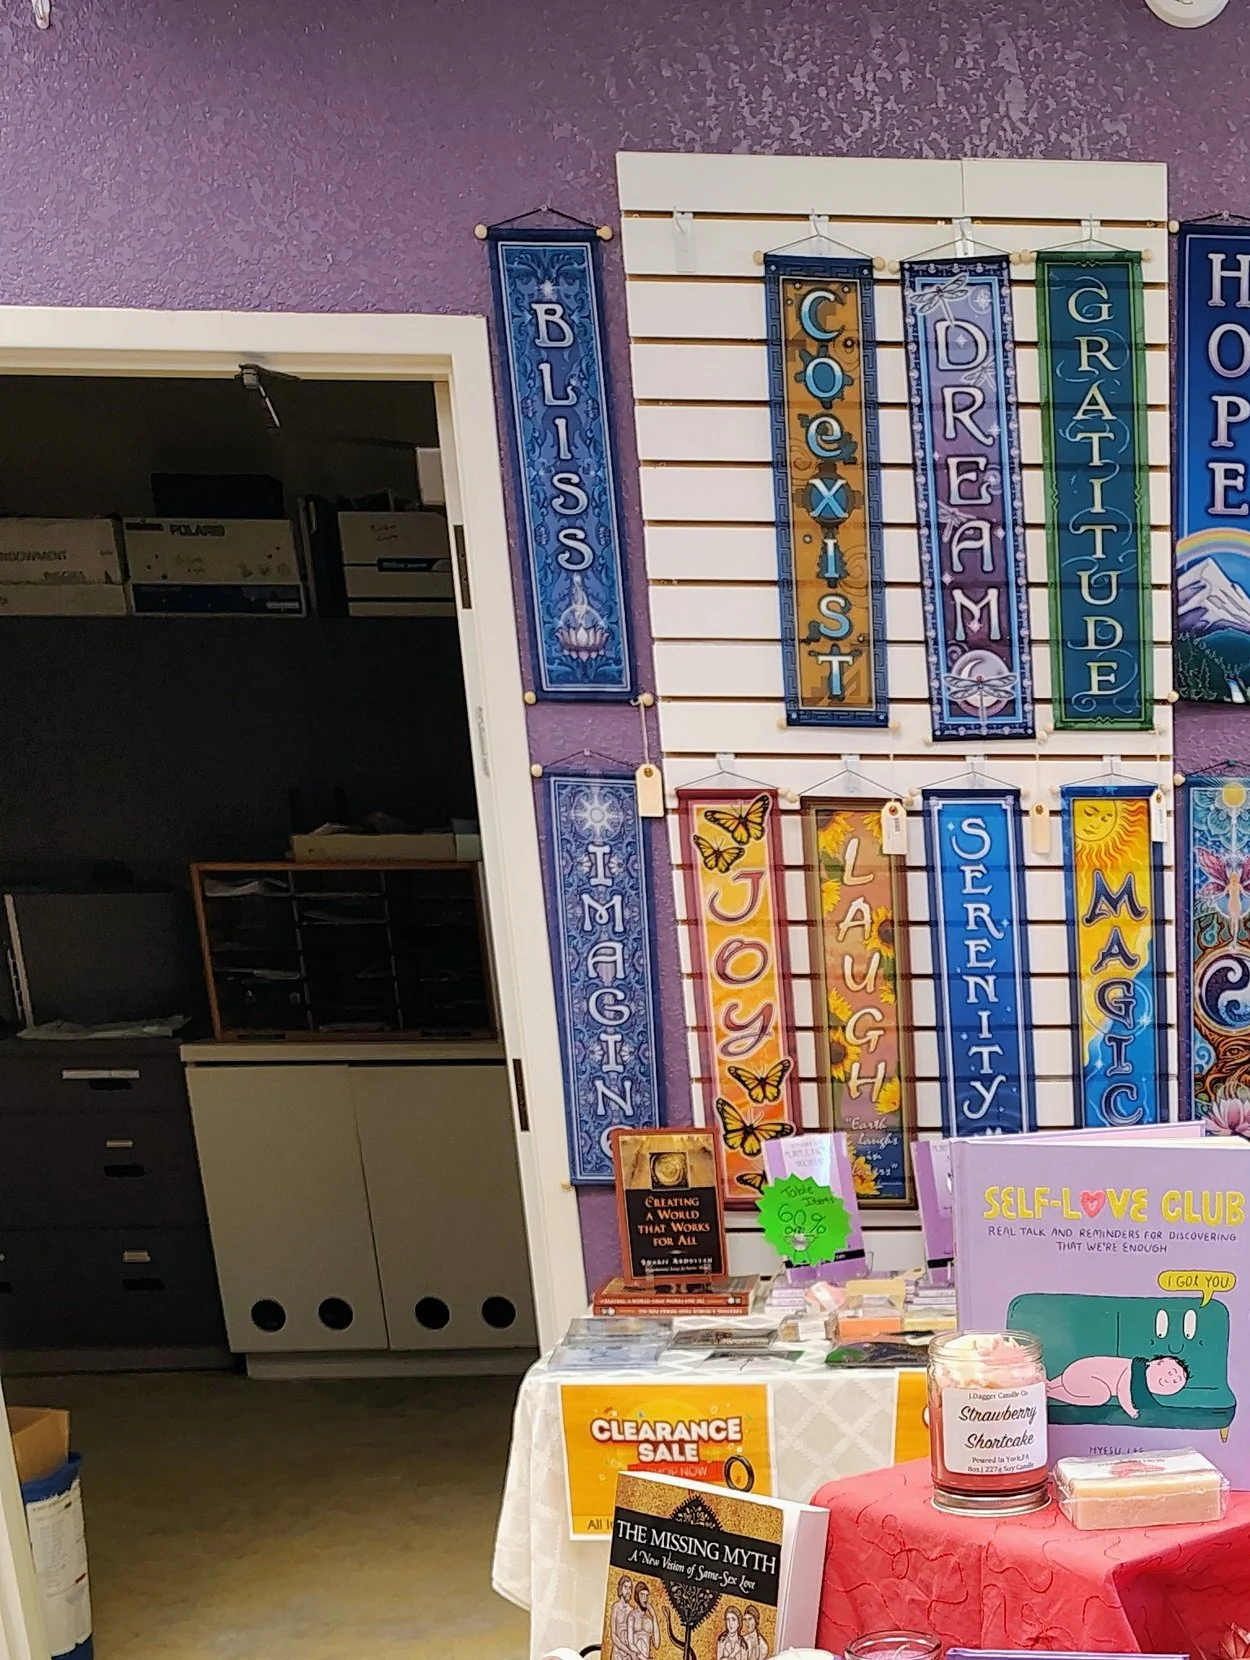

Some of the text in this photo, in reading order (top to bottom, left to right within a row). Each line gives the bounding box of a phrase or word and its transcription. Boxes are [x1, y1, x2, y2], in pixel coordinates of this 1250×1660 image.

[533, 302, 595, 572] BLISS
[935, 319, 1001, 642] DREAM
[1068, 281, 1125, 698] GRATITUDE
[708, 868, 777, 1059] JOY
[838, 836, 886, 1102] LAUGH
[948, 816, 1005, 1119] SERENITY
[1081, 869, 1148, 1126] MAGIC
[1161, 1190, 1246, 1227] CLUB
[988, 1226, 1237, 1242] REAL TALK AND REMINDERS FOR DISCOVERING
[1056, 1240, 1168, 1253] THAT WE'RE ENOUGH
[591, 1417, 743, 1443] CLEARANCE
[959, 1405, 1037, 1425] Strawberry
[638, 1442, 700, 1463] SALE
[965, 1430, 1034, 1449] Shortcake
[617, 1520, 776, 1575] THE MISSING MYTH
[639, 1551, 660, 1567] New
[662, 1552, 685, 1573] Vision
[687, 1563, 696, 1579] of
[695, 1566, 737, 1587] Same-Sex
